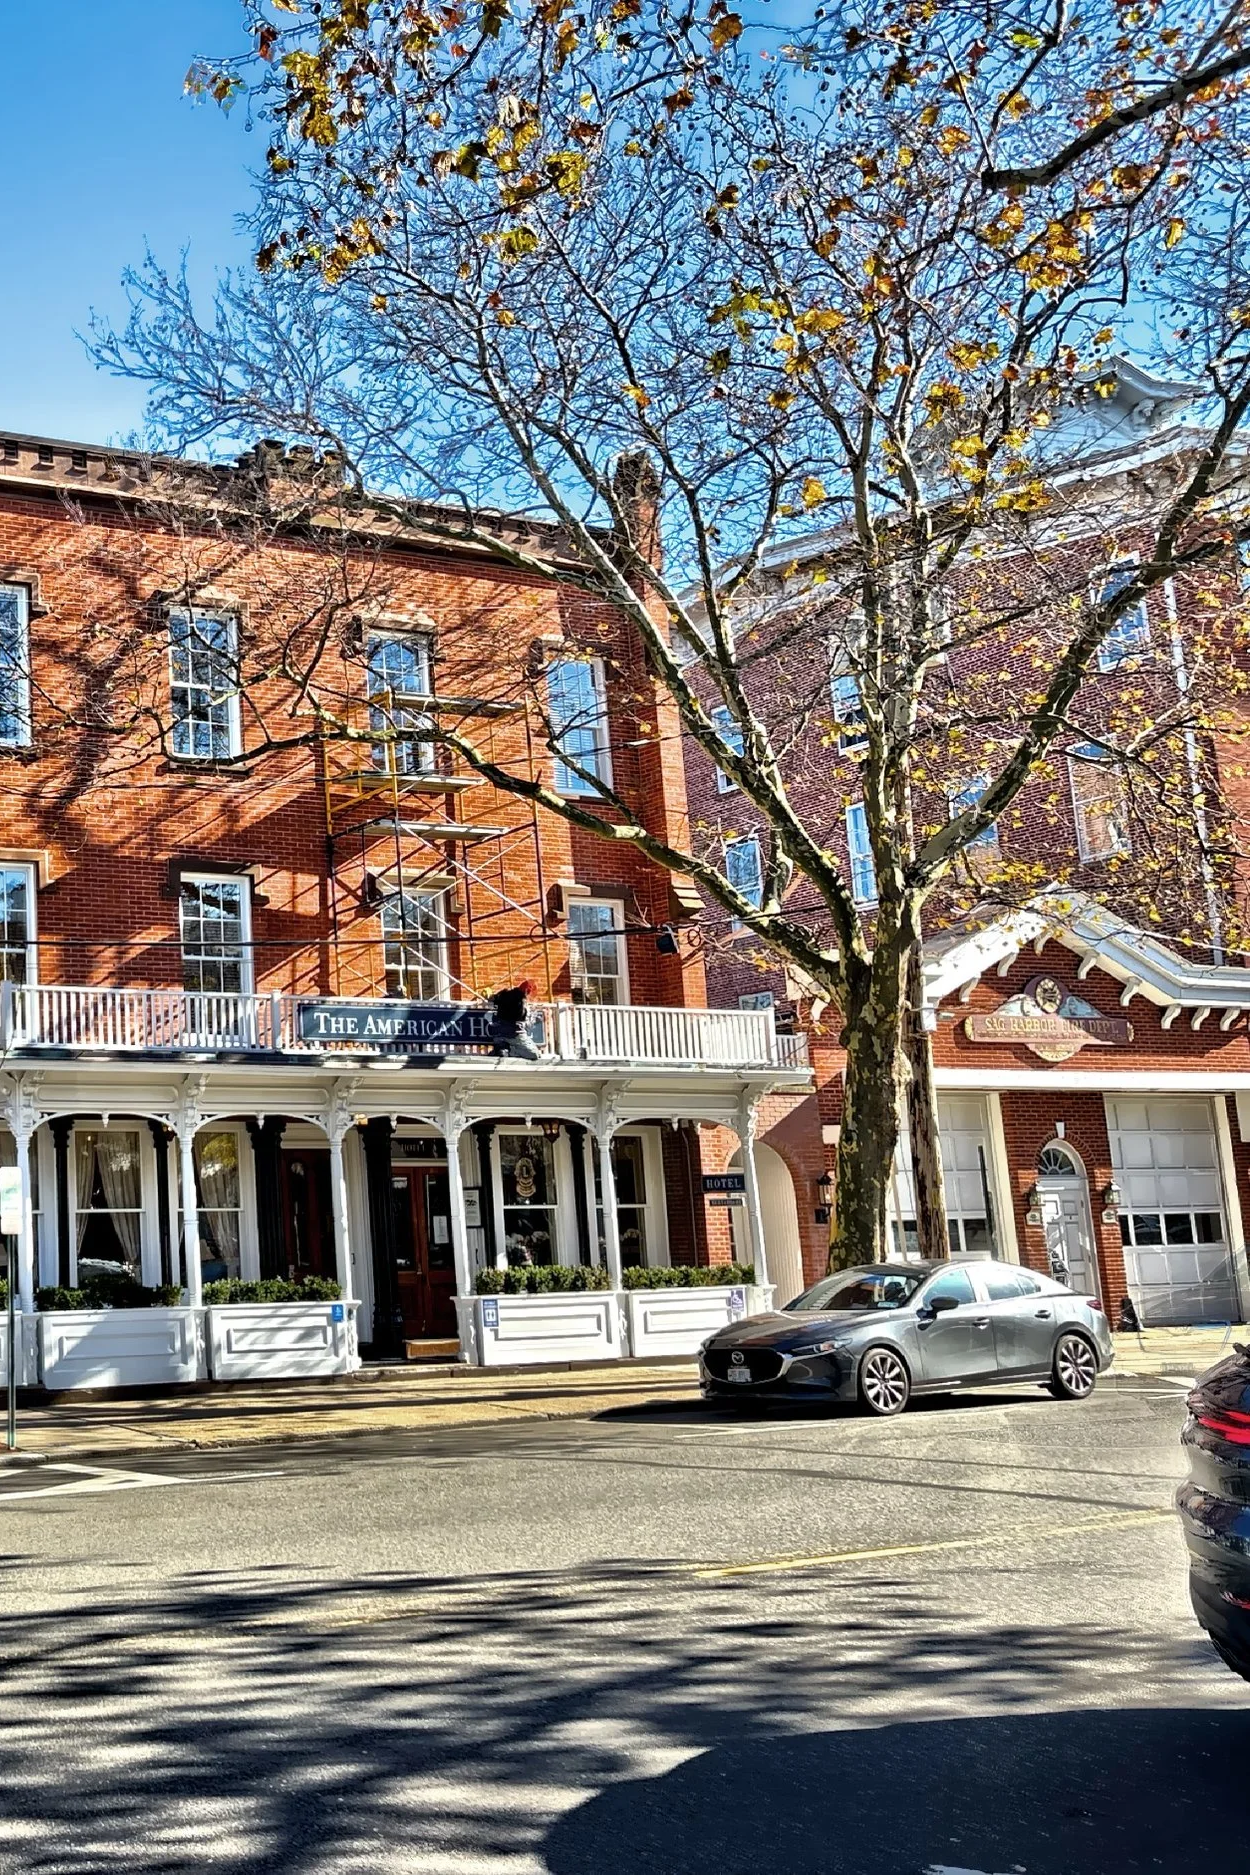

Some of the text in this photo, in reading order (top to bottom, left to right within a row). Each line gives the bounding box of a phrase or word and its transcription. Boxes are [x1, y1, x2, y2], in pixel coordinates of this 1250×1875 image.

[313, 1012, 358, 1035] THE
[363, 1014, 464, 1037] AMERICAN
[985, 1018, 1005, 1031] SAG
[1010, 1018, 1056, 1032] HARBOR
[1061, 1019, 1086, 1033] FIRE
[705, 1178, 741, 1189] HOTEL
